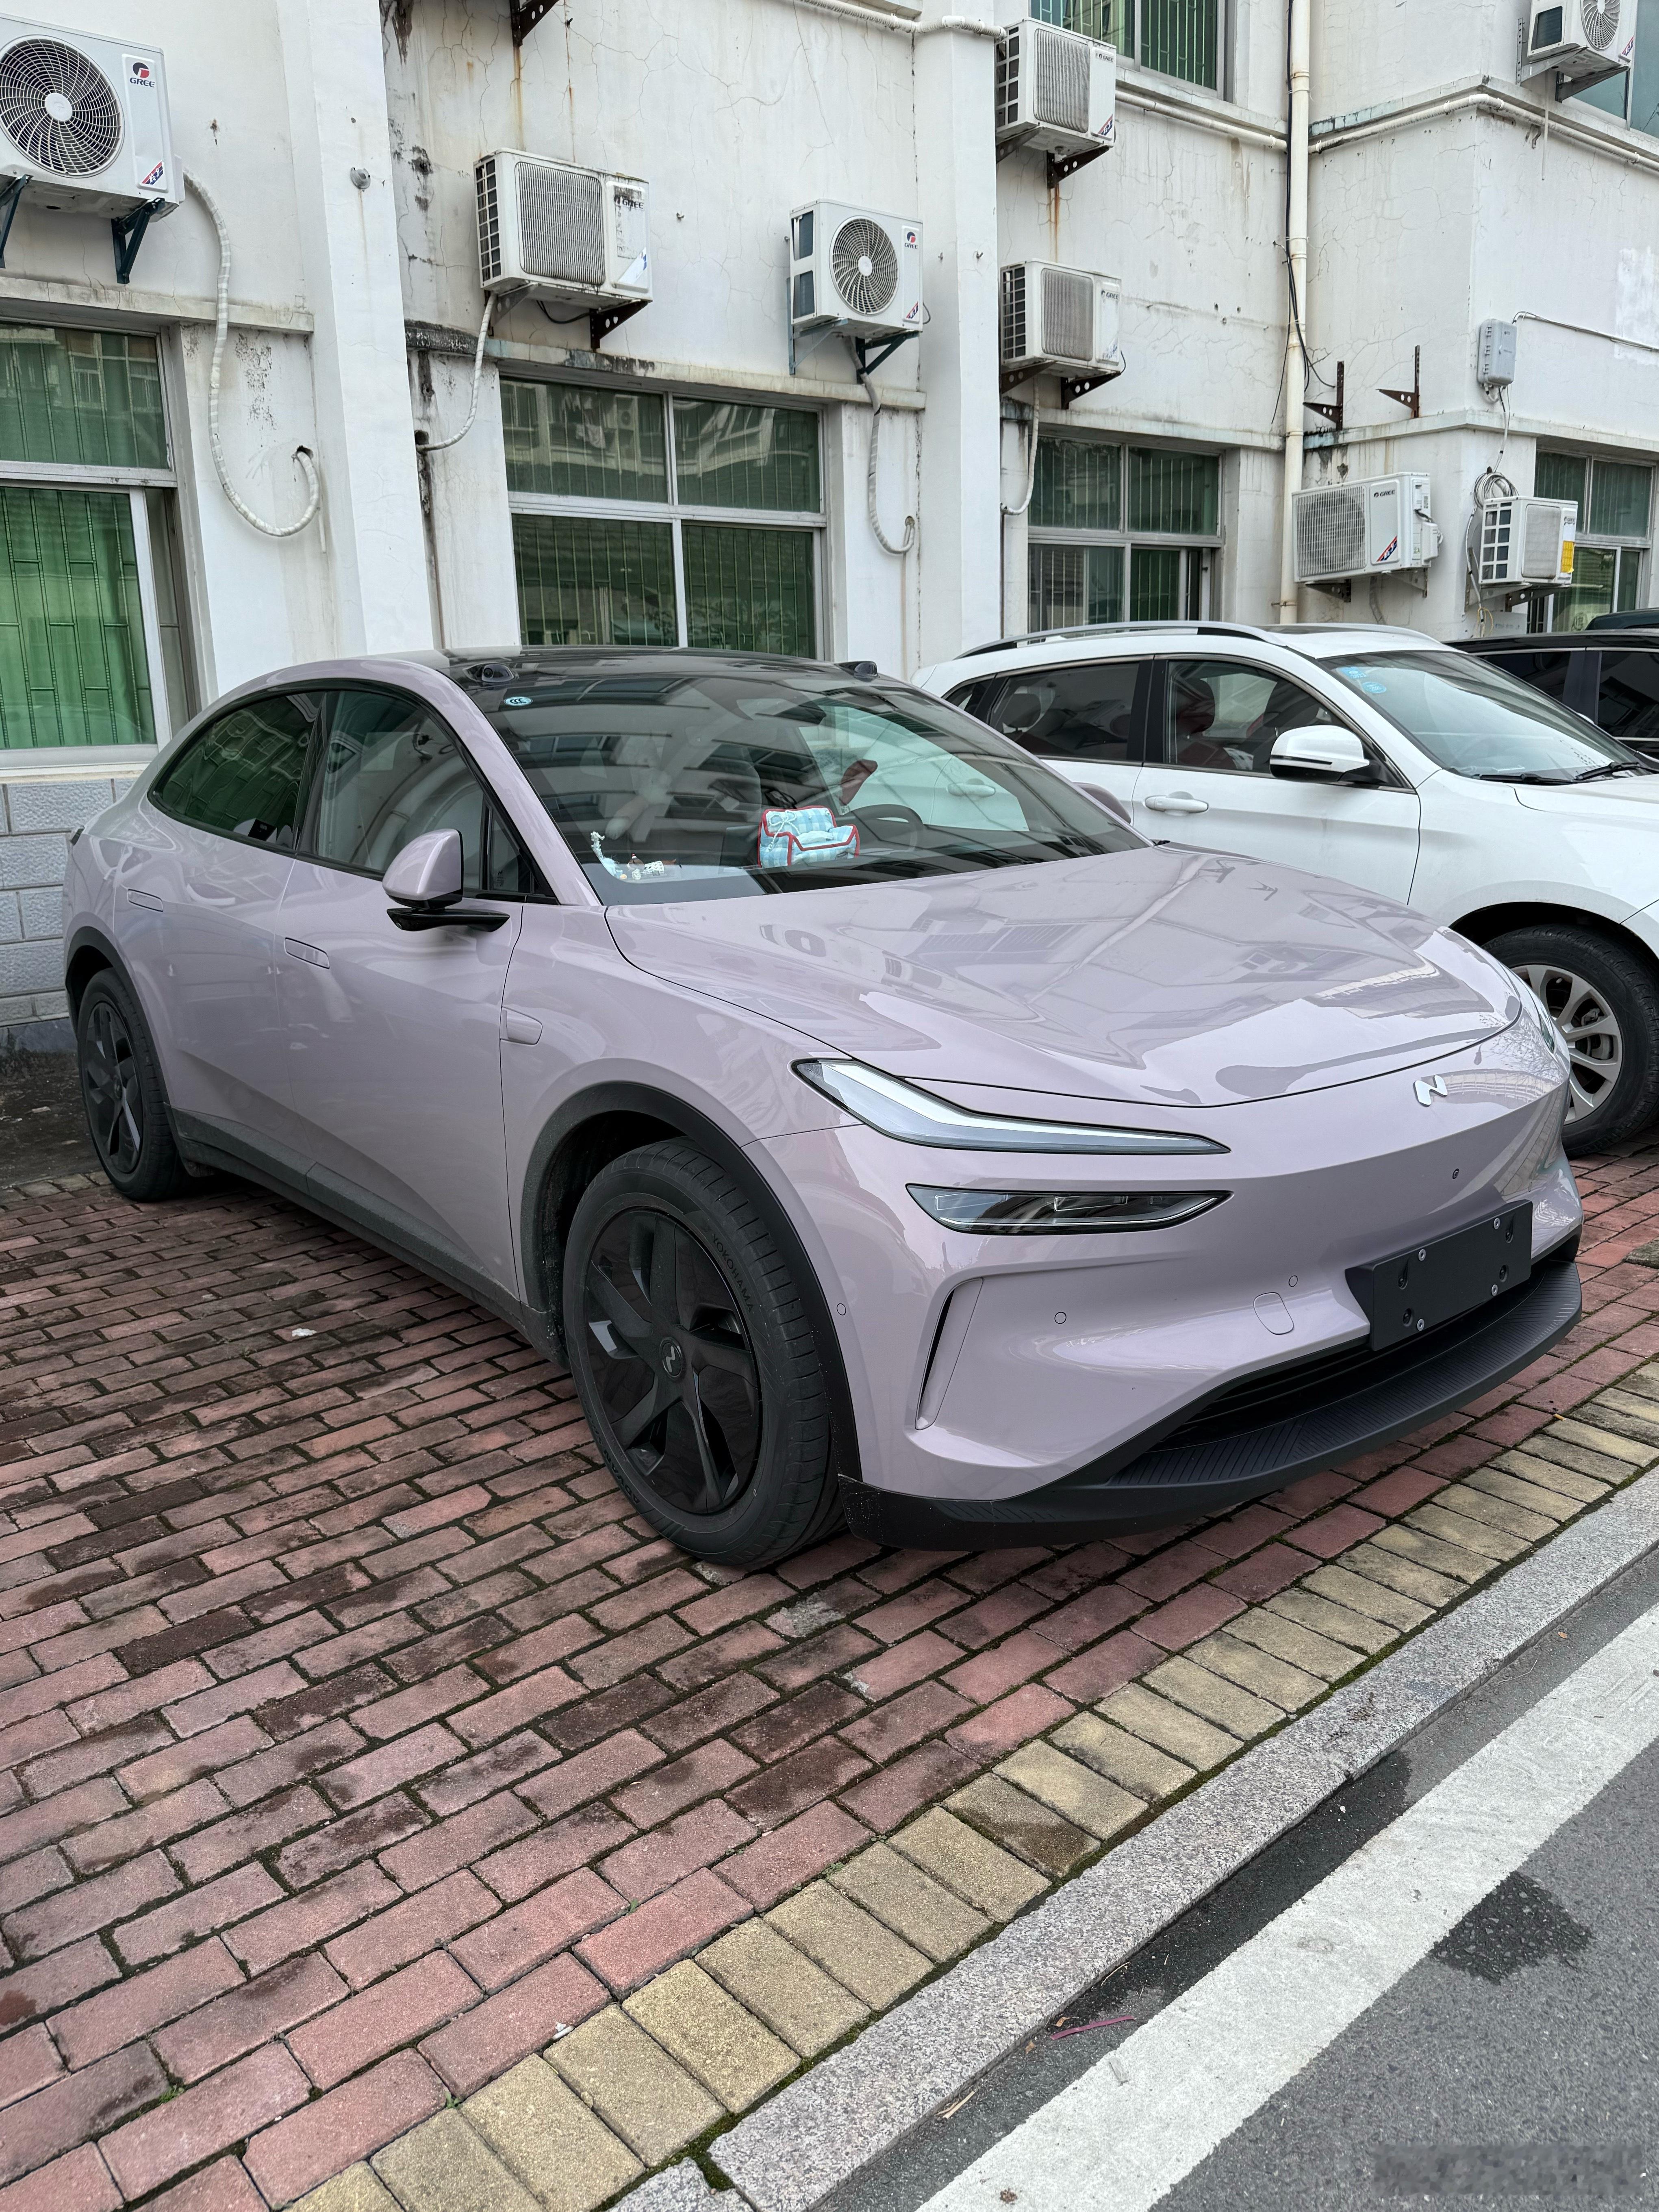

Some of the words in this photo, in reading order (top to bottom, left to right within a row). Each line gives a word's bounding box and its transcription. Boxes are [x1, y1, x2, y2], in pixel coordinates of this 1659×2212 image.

[130, 77, 155, 88] GREE
[622, 198, 644, 209] GREE
[712, 1233, 753, 1313] YOKOHAMA
[604, 1448, 640, 1504] ADVAN
